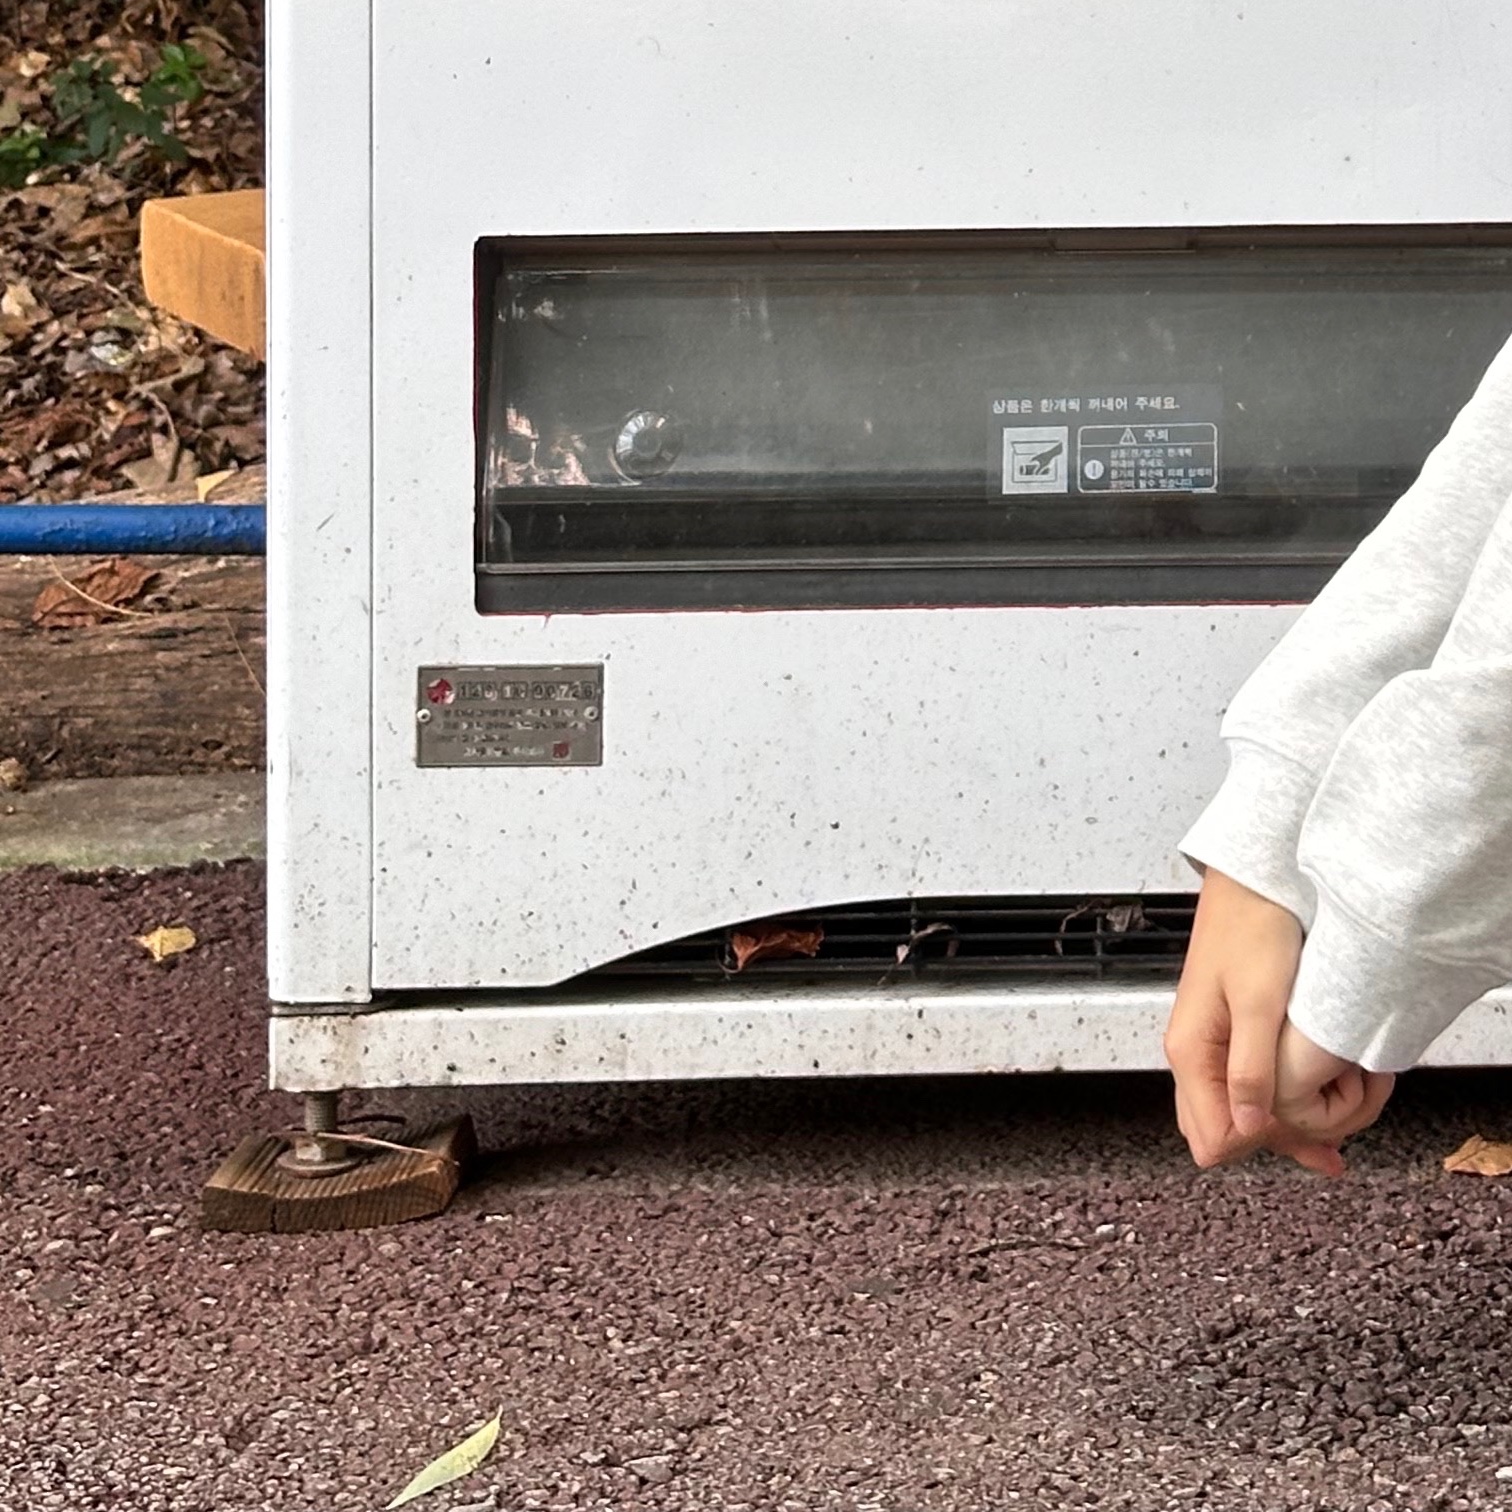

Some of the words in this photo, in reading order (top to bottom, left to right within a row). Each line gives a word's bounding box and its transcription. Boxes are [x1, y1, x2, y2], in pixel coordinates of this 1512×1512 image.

[993, 400, 1032, 414] 상품은
[1040, 398, 1081, 413] 한개씩
[1144, 428, 1169, 442] 주의
